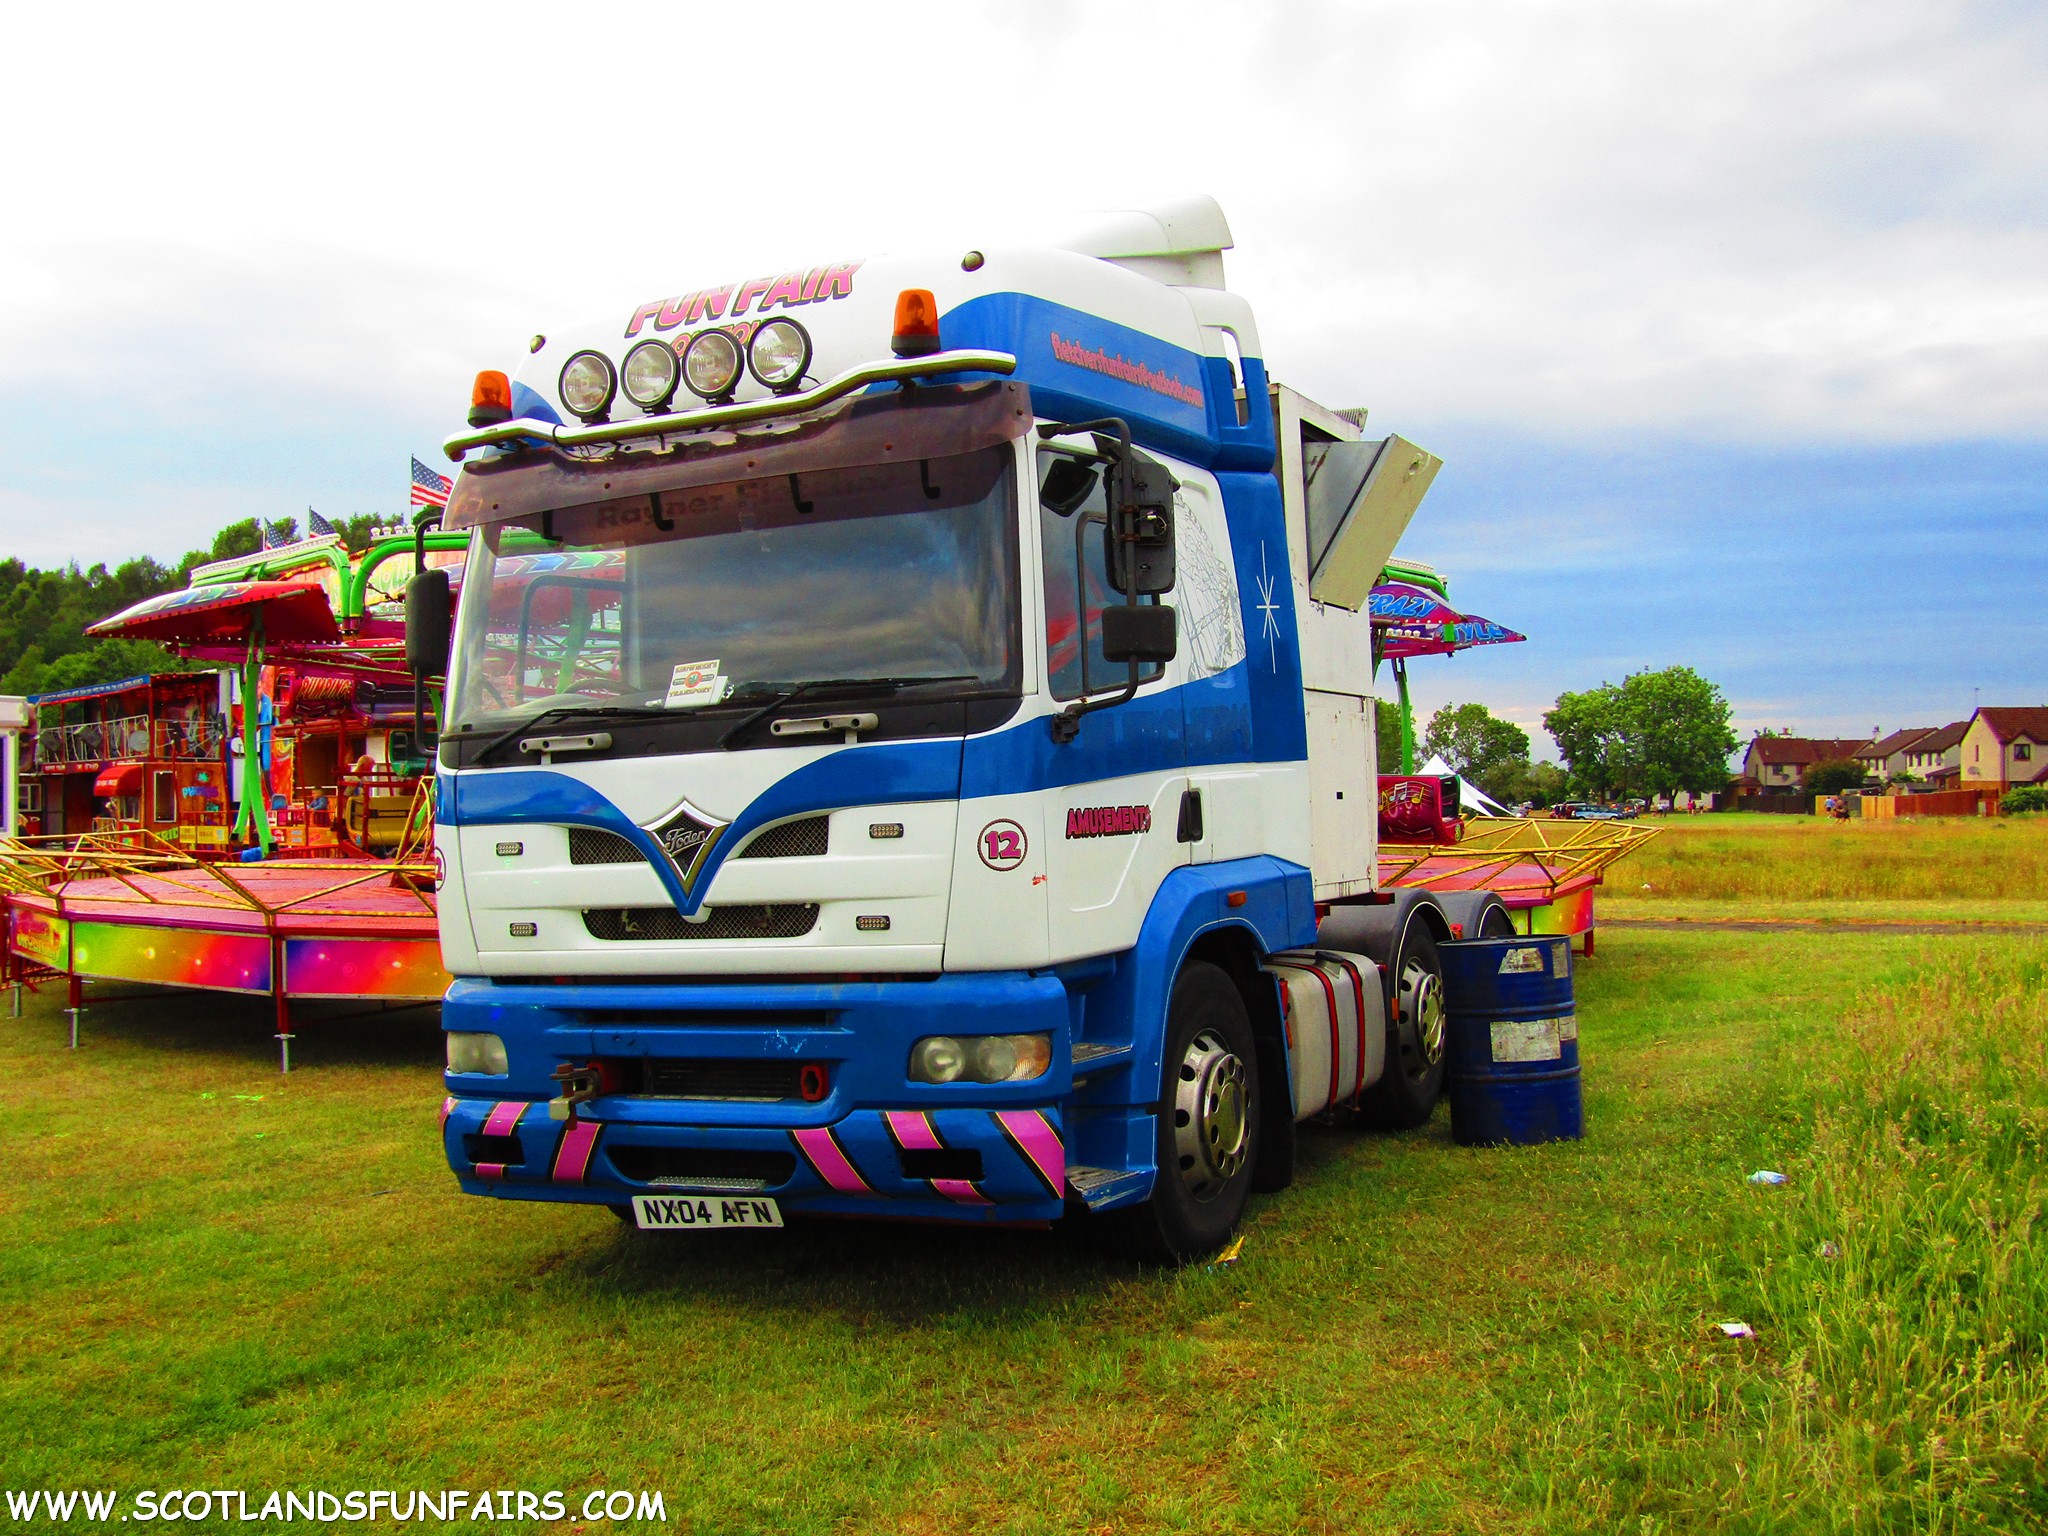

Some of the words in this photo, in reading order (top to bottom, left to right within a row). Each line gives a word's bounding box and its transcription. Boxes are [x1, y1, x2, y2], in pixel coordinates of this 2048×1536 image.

[625, 284, 734, 338] FUN
[731, 258, 866, 316] FAIR
[664, 827, 707, 855] Foden
[984, 830, 1023, 860] 12
[643, 1200, 712, 1225] NX04
[721, 1199, 773, 1225] AFN
